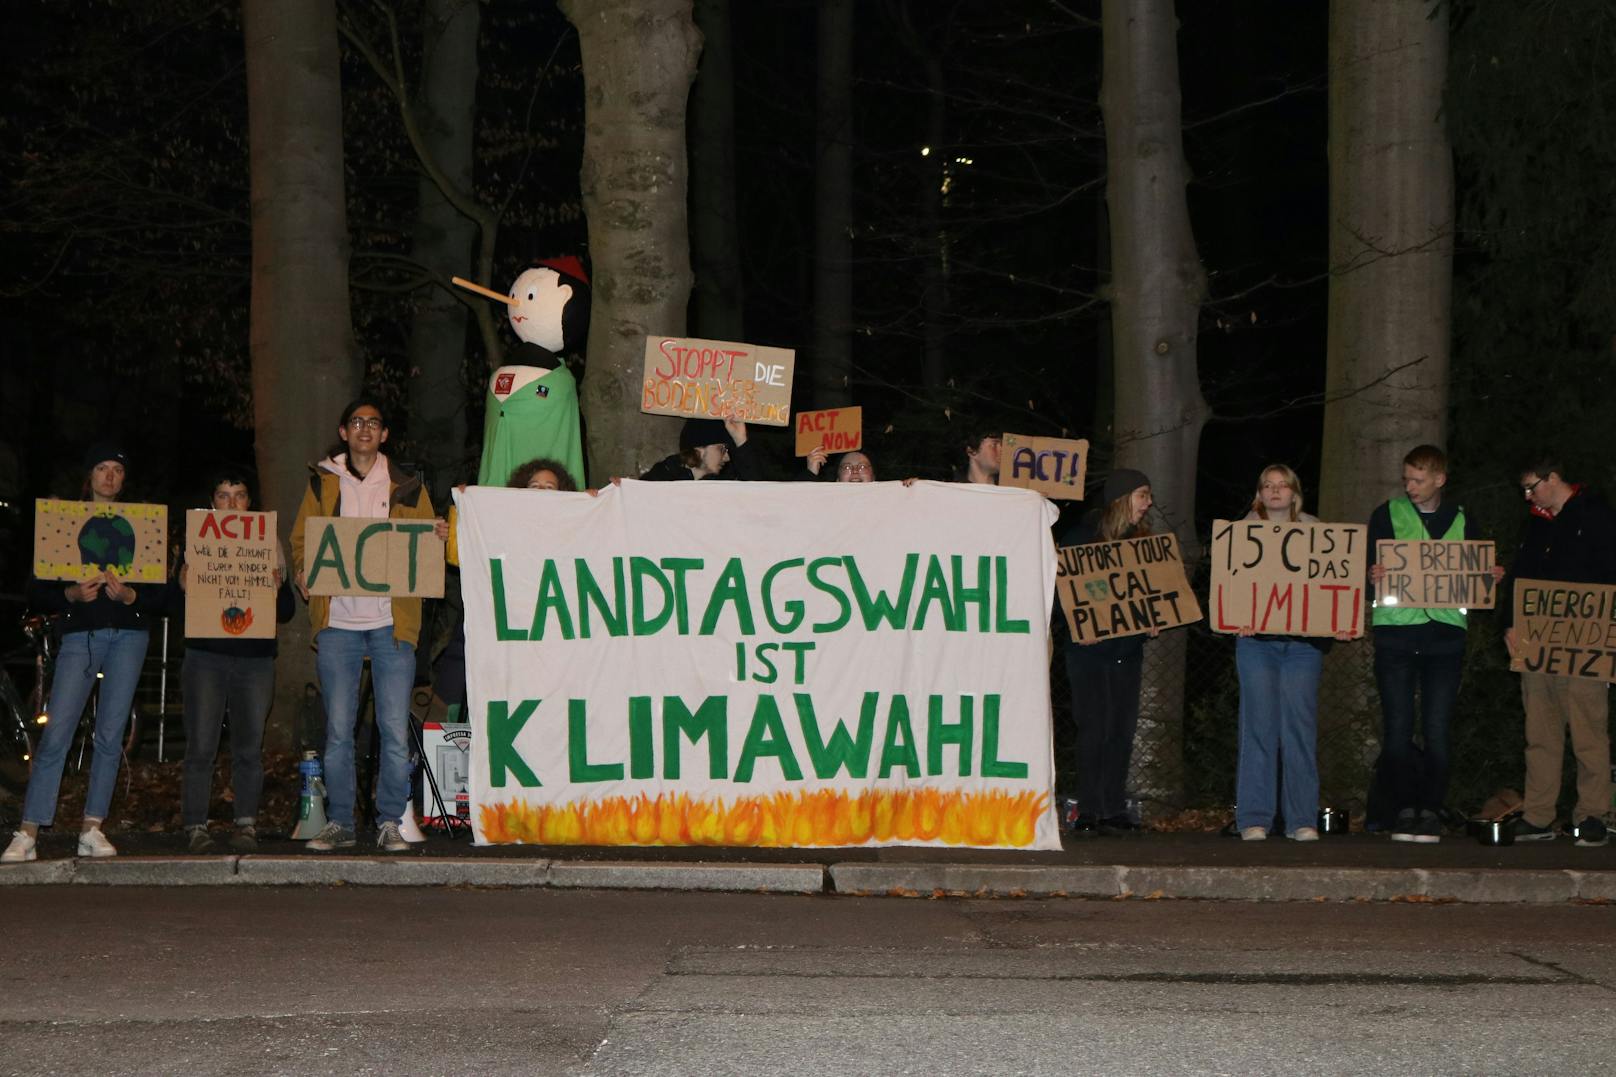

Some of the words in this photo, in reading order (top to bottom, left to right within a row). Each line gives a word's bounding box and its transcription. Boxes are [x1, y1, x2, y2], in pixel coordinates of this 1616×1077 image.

[656, 339, 748, 384] STOPPT
[754, 362, 785, 386] DIE
[799, 411, 839, 433] ACT
[822, 432, 859, 450] NOW
[1012, 447, 1080, 486] ACT!
[199, 512, 266, 541] ACT!
[1310, 527, 1358, 553] IST
[235, 546, 272, 560] ZUKUNFT
[239, 562, 267, 573] KINDER
[307, 522, 434, 593] ACT
[1056, 542, 1124, 577] SUPPORT
[1128, 535, 1176, 566] YOUR
[1308, 558, 1350, 579] DAS
[1378, 543, 1409, 571] ES
[197, 572, 221, 585] NICHT
[225, 575, 240, 585] VOM
[244, 575, 272, 588] HIMMEL
[1423, 573, 1494, 605] PENNT!
[489, 553, 1030, 641] LANDTAGSWAHL
[1218, 582, 1361, 636] LIMIT!
[1523, 588, 1616, 622] ENERGIE
[1073, 591, 1182, 640] PLANET
[1527, 619, 1616, 649] WENDE
[736, 641, 815, 684] IST
[1524, 647, 1616, 678] JETZT
[487, 691, 1029, 788] KLIMAWAHL
